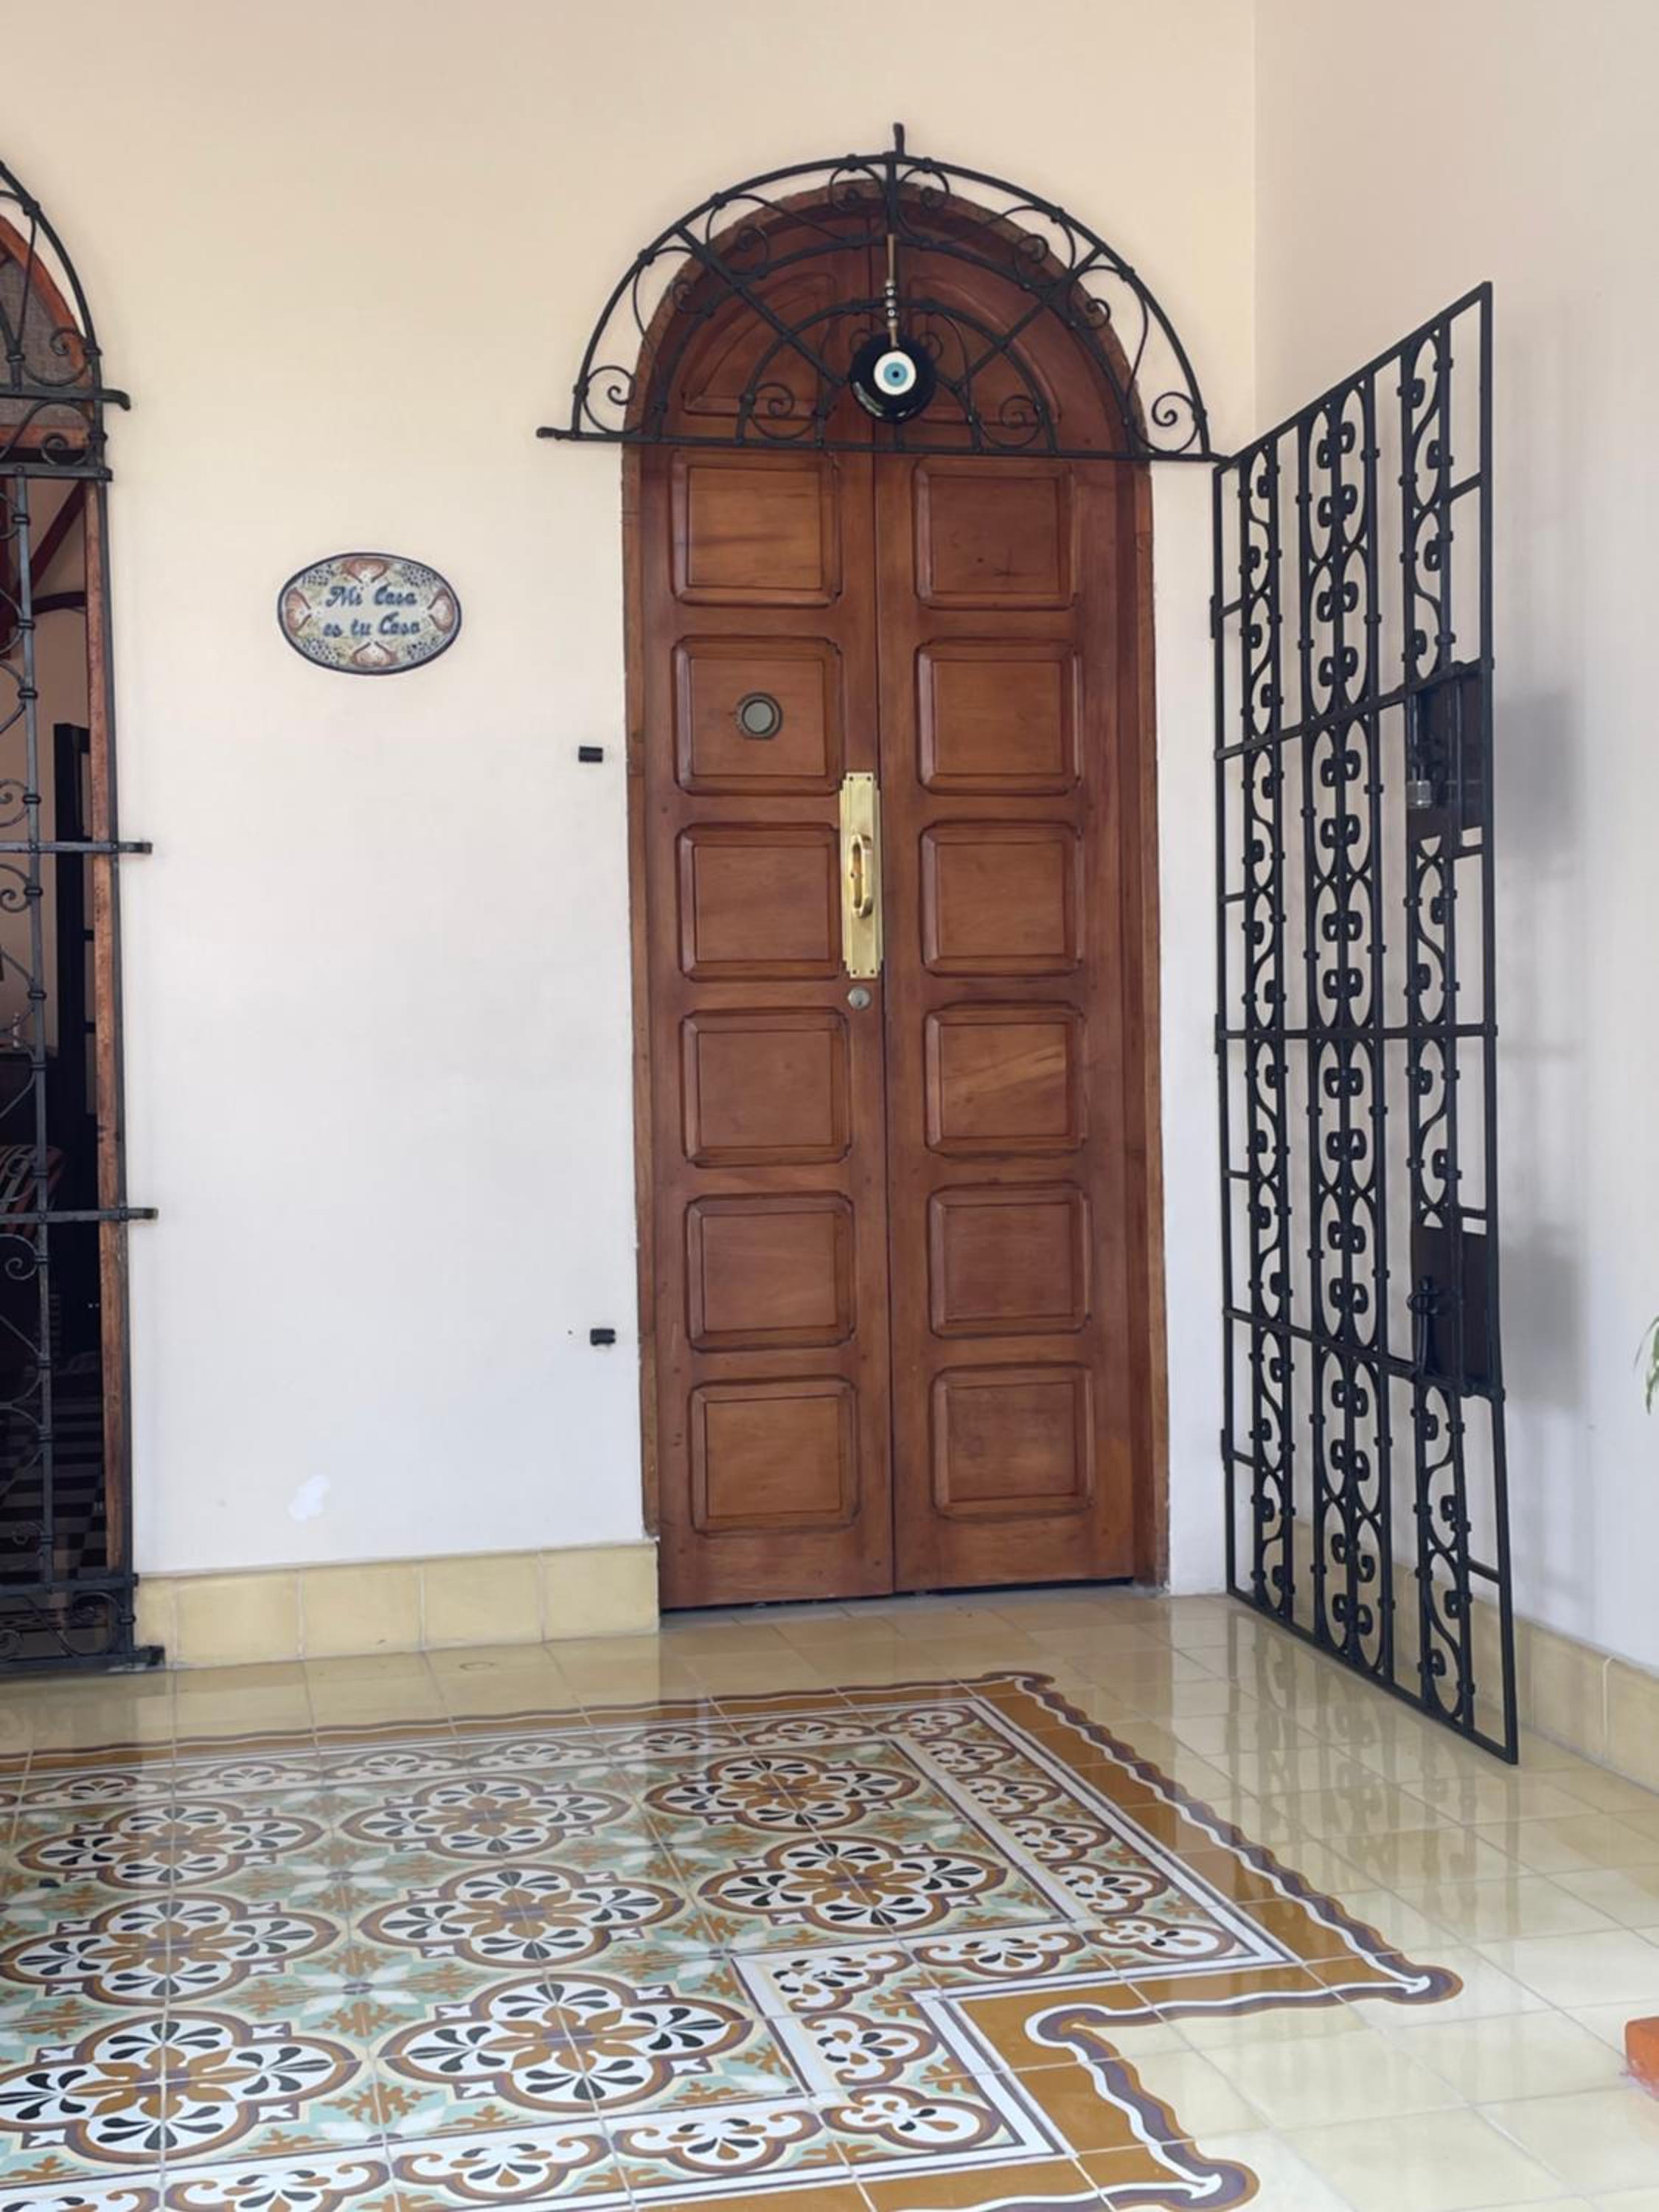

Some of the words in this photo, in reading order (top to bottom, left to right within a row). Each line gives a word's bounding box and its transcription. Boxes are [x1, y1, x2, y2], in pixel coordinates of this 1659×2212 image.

[326, 585, 363, 607] Mi
[373, 582, 417, 605] Casa
[323, 623, 343, 637] es
[350, 619, 372, 636] tu
[378, 611, 421, 636] Casa
